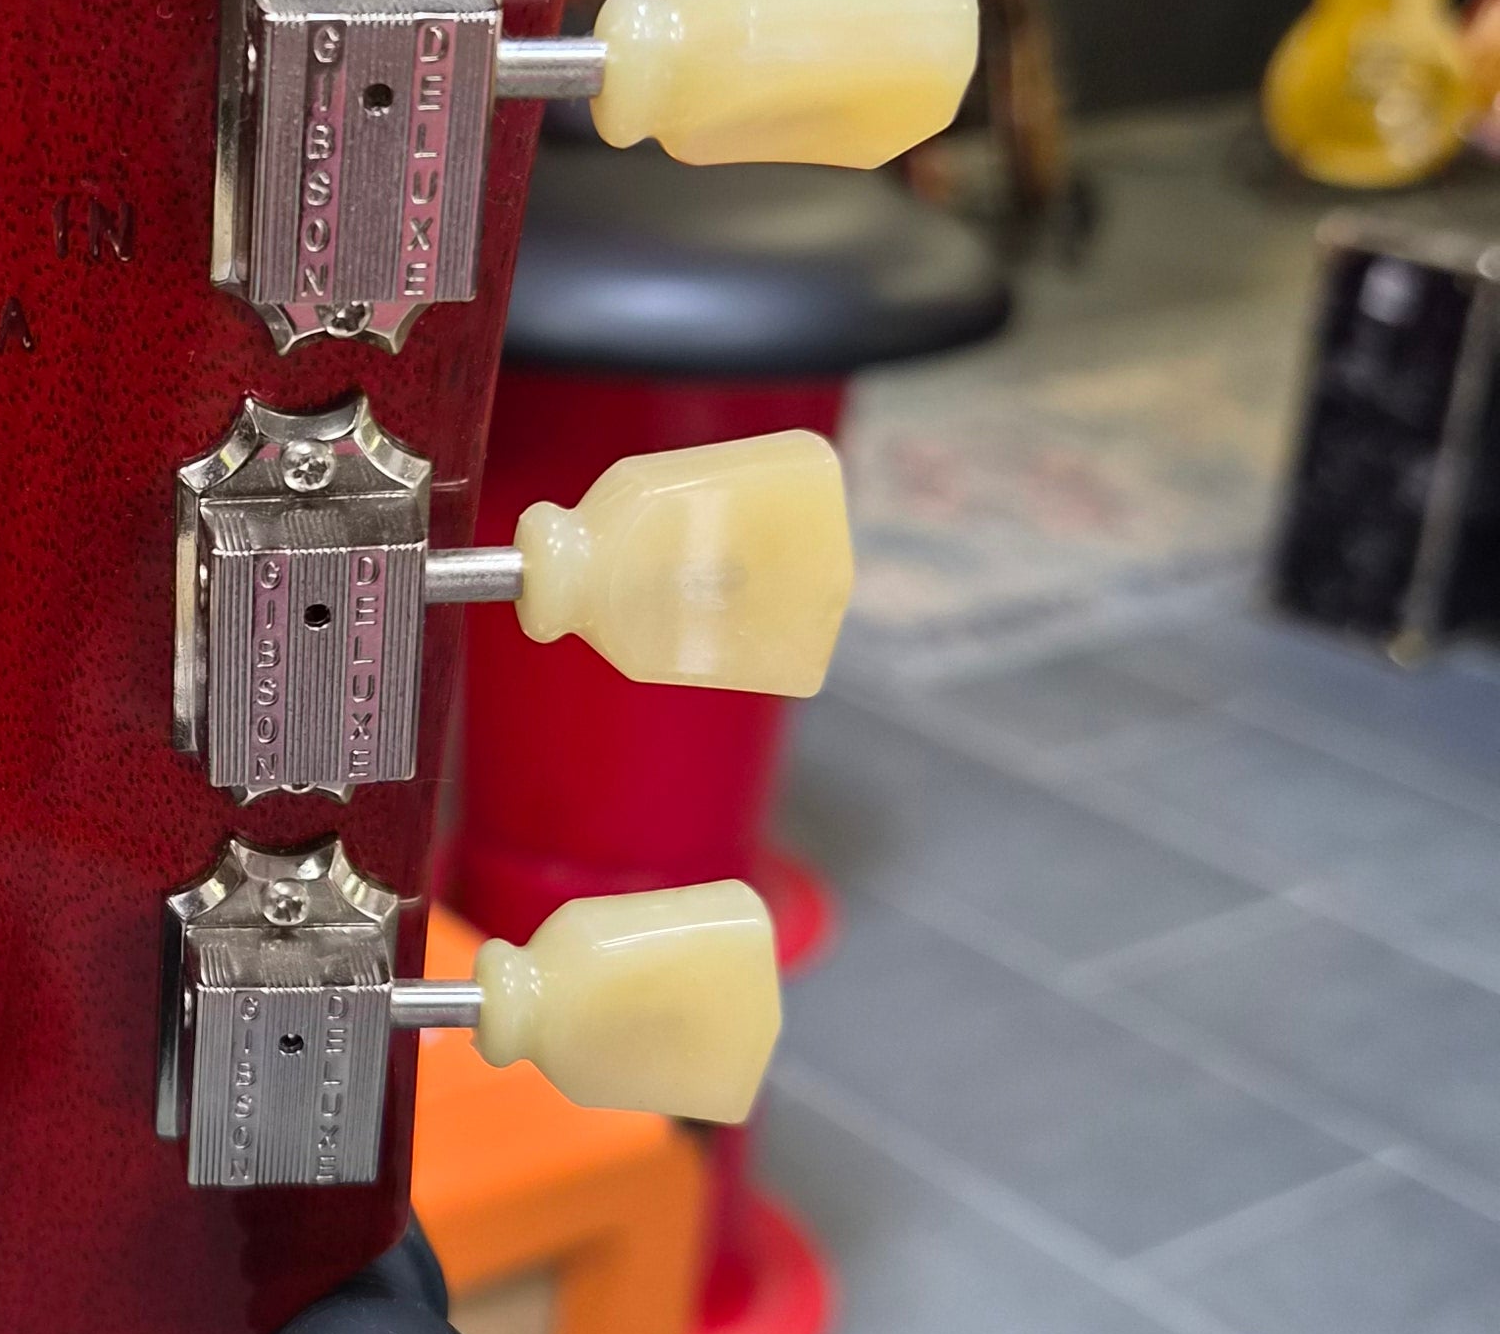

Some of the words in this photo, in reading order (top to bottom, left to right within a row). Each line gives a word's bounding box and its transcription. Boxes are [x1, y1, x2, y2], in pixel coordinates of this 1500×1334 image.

[53, 195, 137, 262] IN
[301, 25, 342, 298] GIBSON
[402, 25, 449, 296] DELUXE
[254, 559, 283, 781] GIBSON
[348, 555, 381, 779] DELUXE
[229, 995, 261, 1181] GIBSON
[316, 994, 349, 1185] DELUXE
